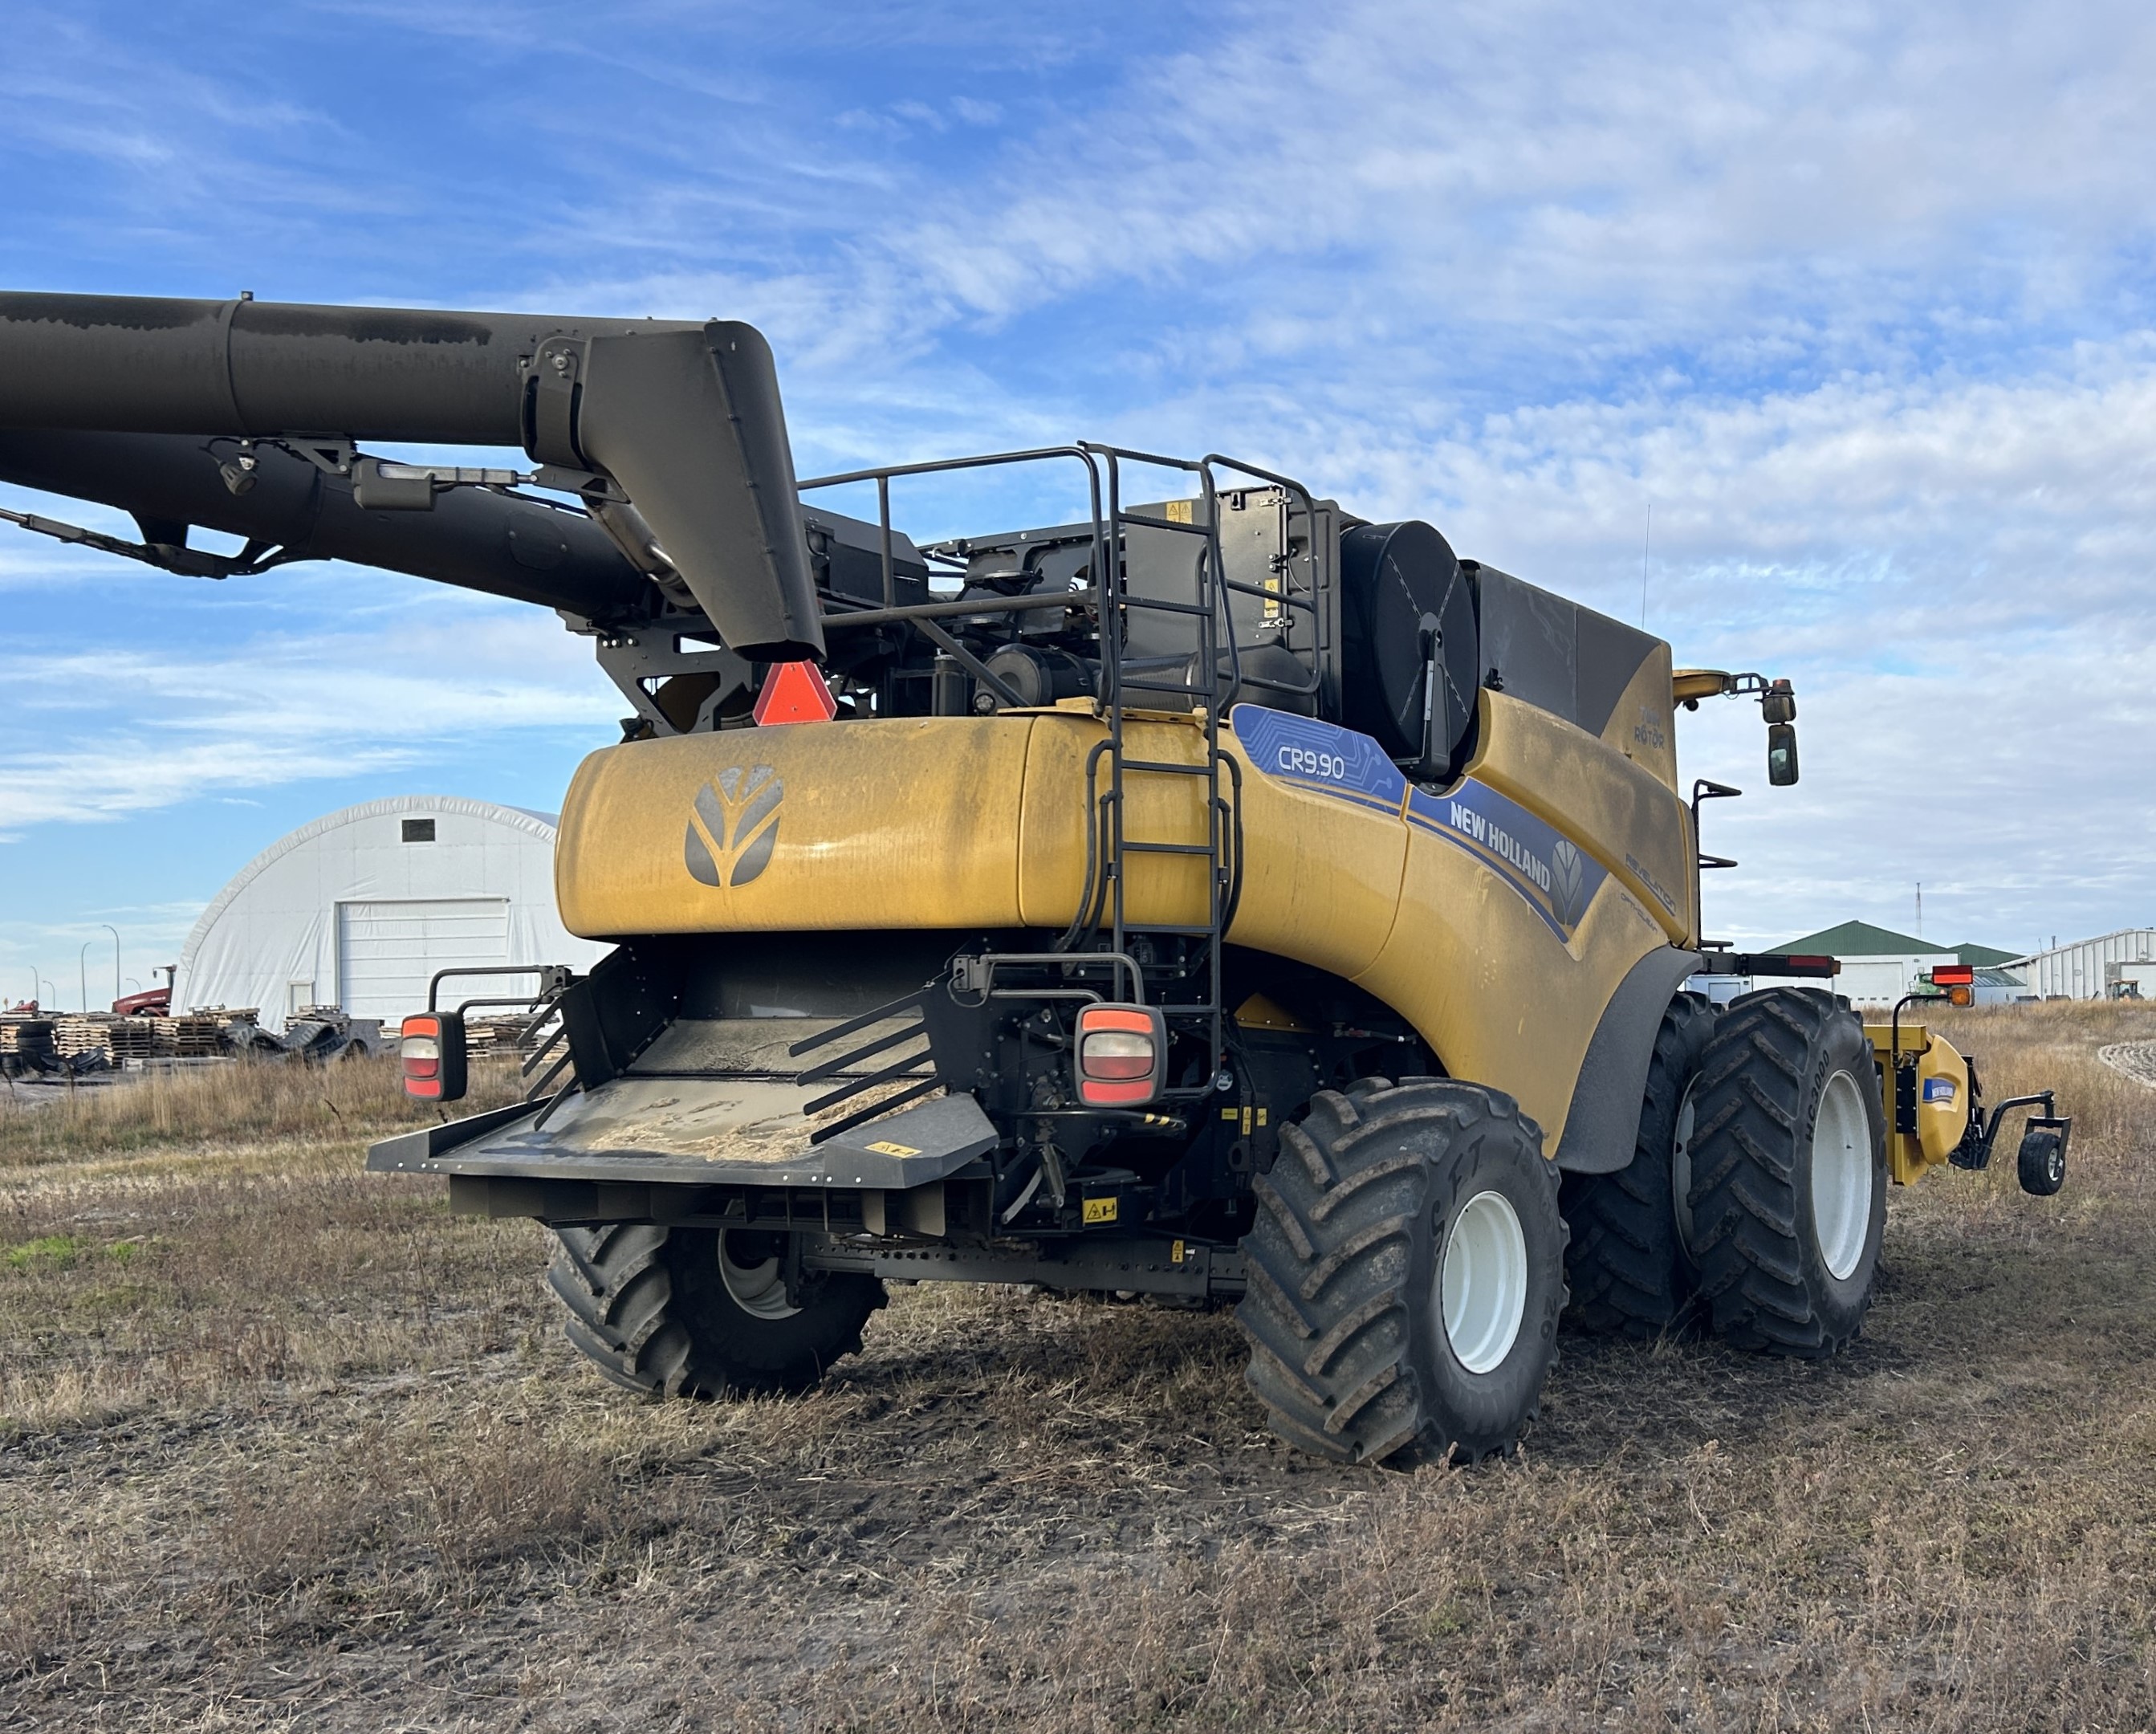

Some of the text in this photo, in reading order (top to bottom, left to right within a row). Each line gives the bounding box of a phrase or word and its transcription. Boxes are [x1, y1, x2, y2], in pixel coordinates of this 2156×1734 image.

[1278, 746, 1345, 780] CR9.90
[1450, 800, 1551, 893] NEW HOLLAND
